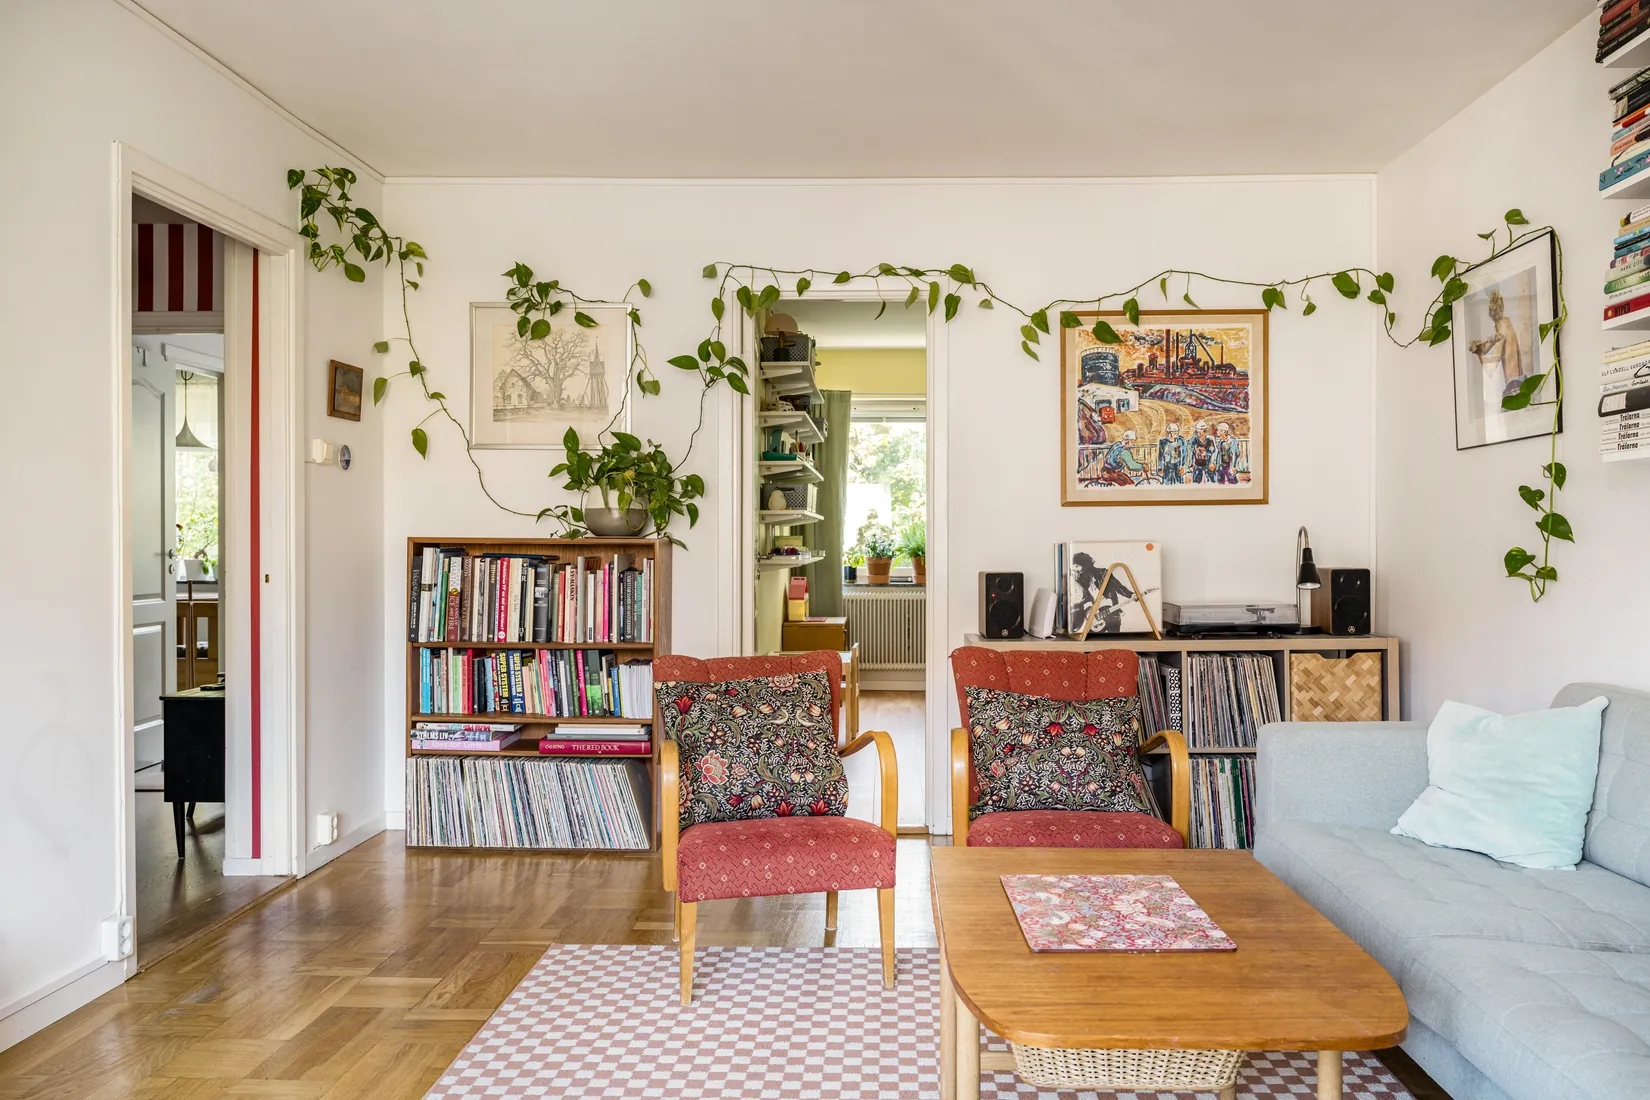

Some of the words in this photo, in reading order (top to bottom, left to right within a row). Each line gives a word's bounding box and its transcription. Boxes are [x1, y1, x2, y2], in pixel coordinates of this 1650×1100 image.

[1610, 366, 1629, 375] LUNDELL
[499, 652, 507, 672] SUPER
[500, 673, 509, 697] SYSTEM
[439, 731, 449, 740] LIV
